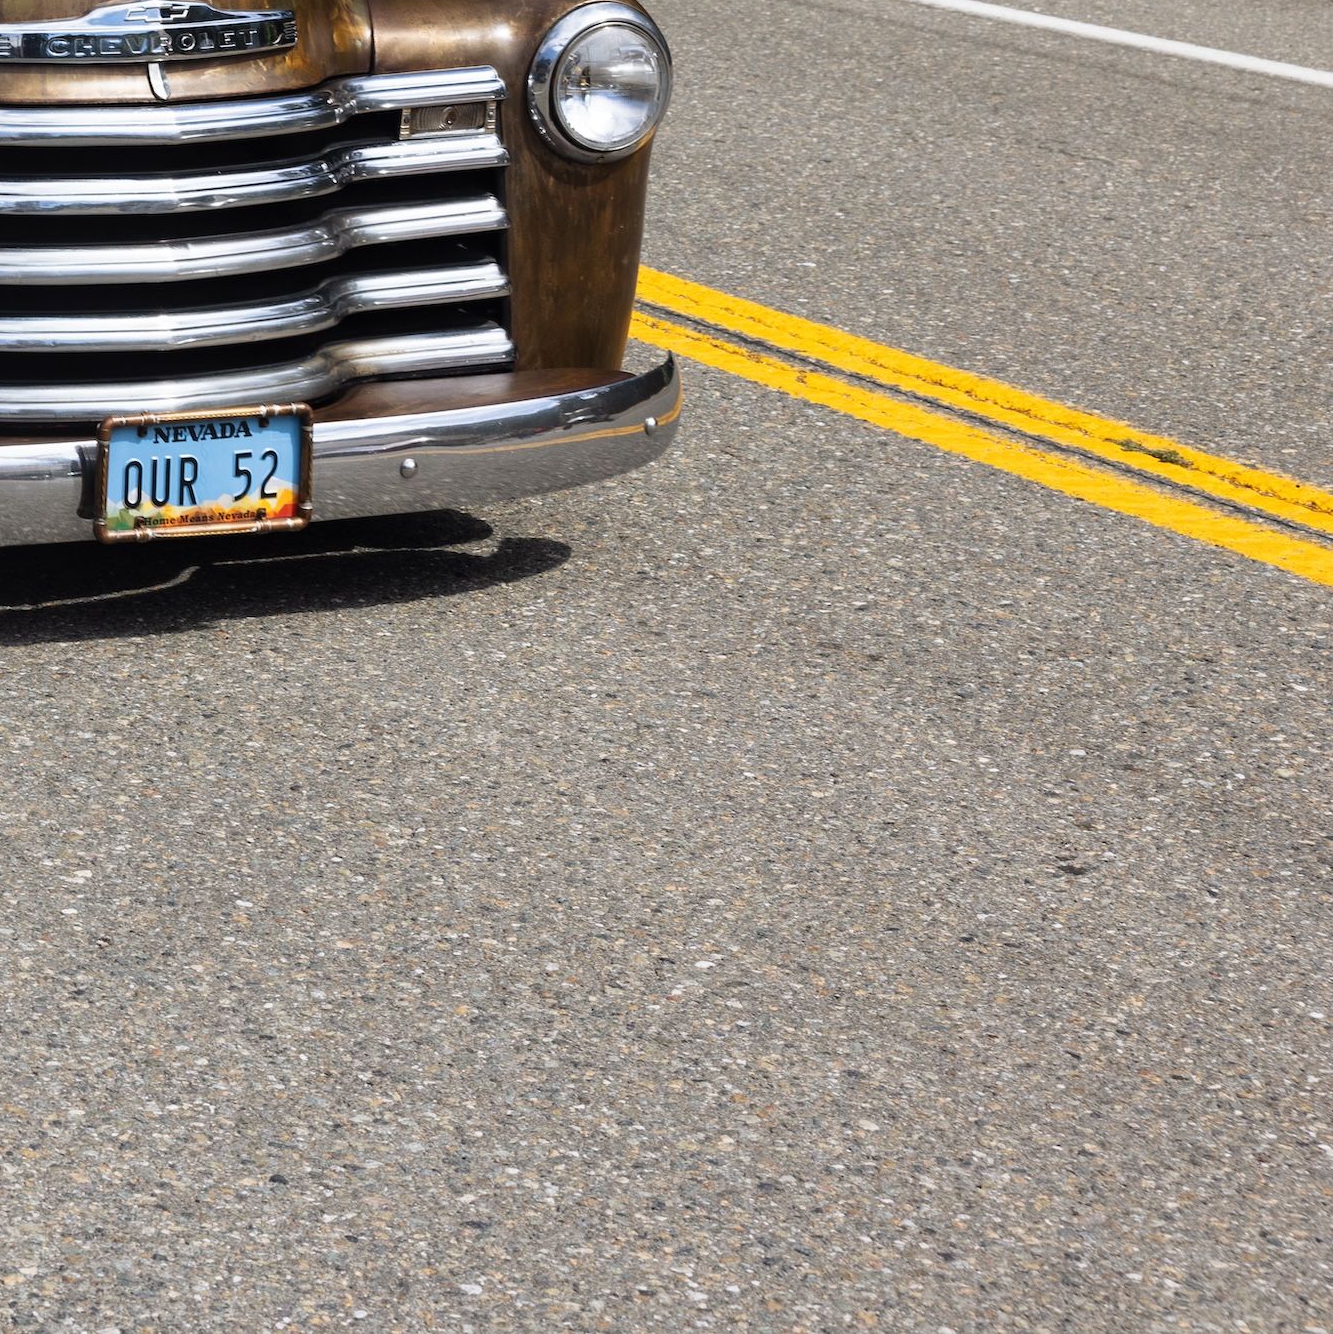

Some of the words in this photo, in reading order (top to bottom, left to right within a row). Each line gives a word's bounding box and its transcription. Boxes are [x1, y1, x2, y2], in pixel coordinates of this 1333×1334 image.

[44, 27, 258, 58] CHEVROLET
[153, 420, 252, 444] NEVADA
[123, 456, 199, 509] OUR
[233, 450, 279, 502] 52
[144, 516, 175, 527] Home
[180, 513, 215, 524] Means
[217, 510, 255, 521] Nevada
